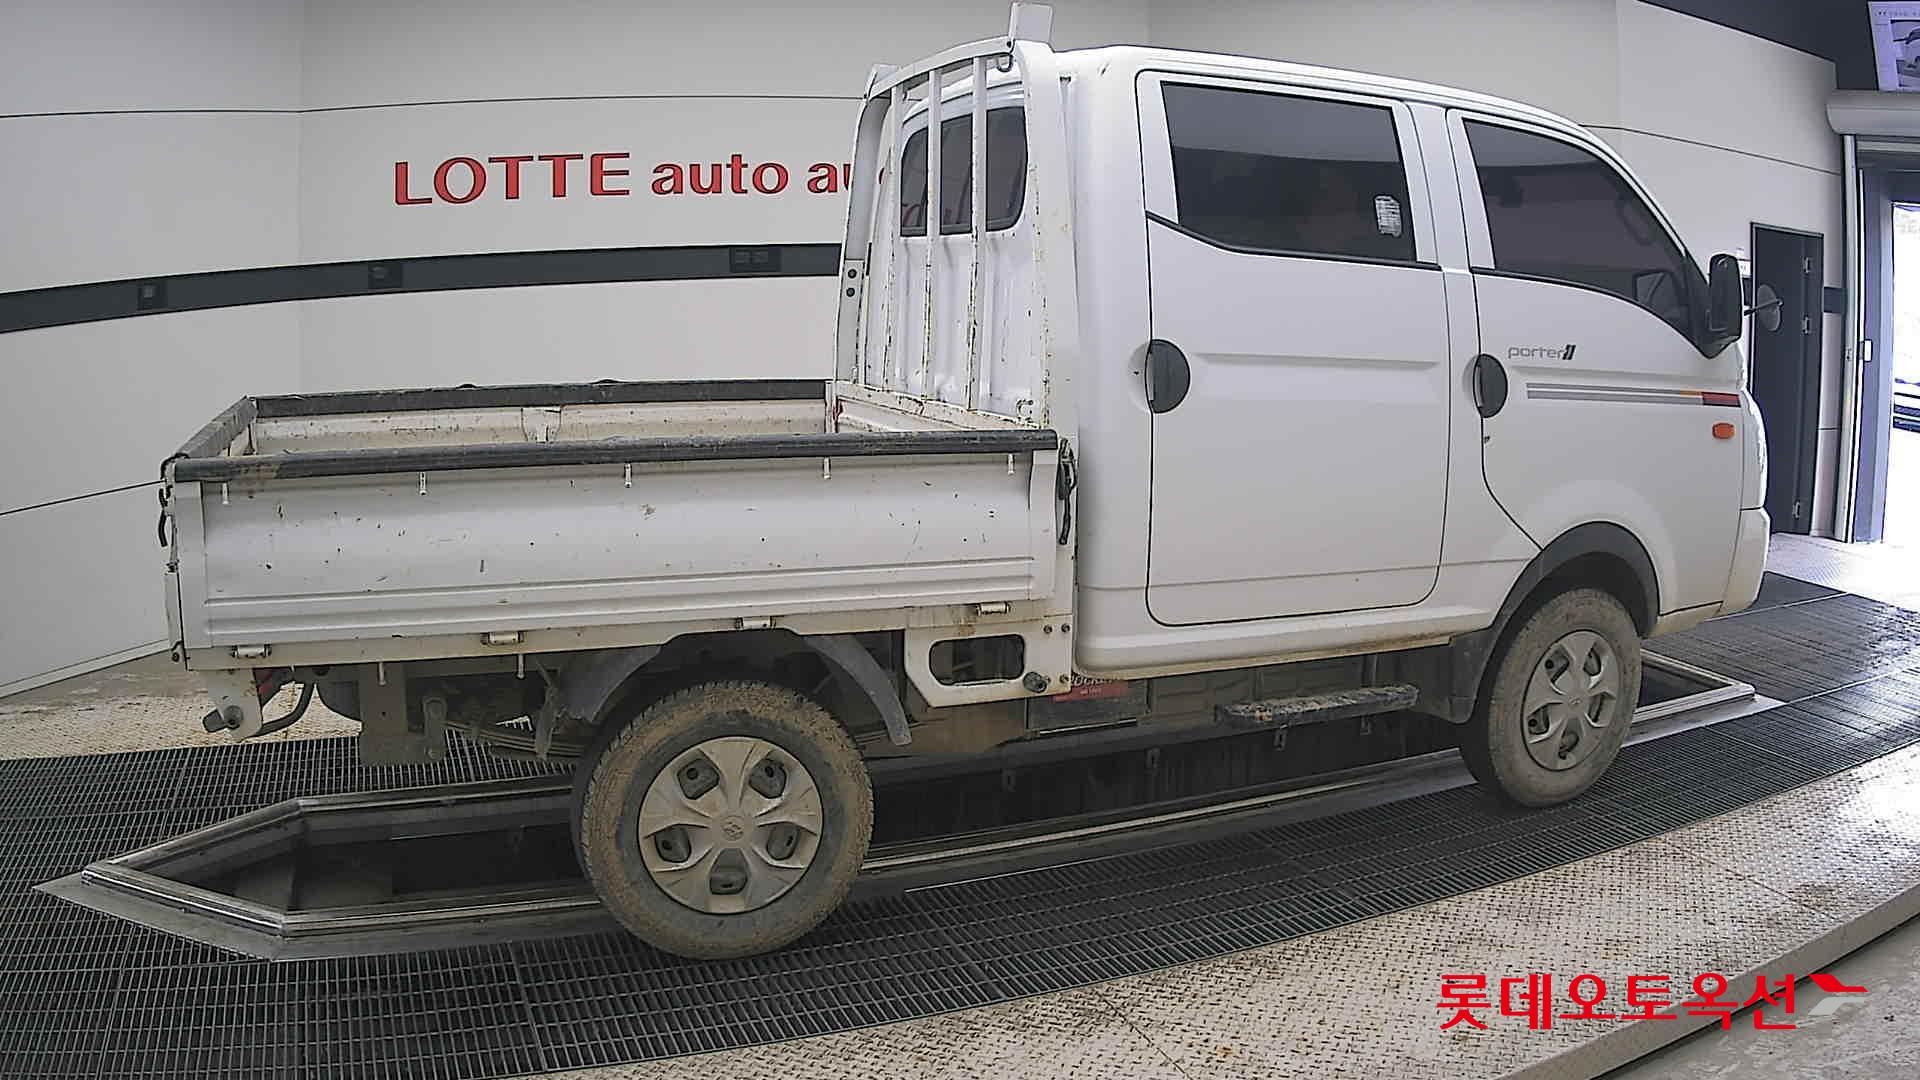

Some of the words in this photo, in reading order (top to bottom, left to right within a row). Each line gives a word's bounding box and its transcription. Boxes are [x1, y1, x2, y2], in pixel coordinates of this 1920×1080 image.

[394, 152, 631, 206] LOTTE
[651, 153, 790, 195] auto
[806, 162, 851, 194] a
